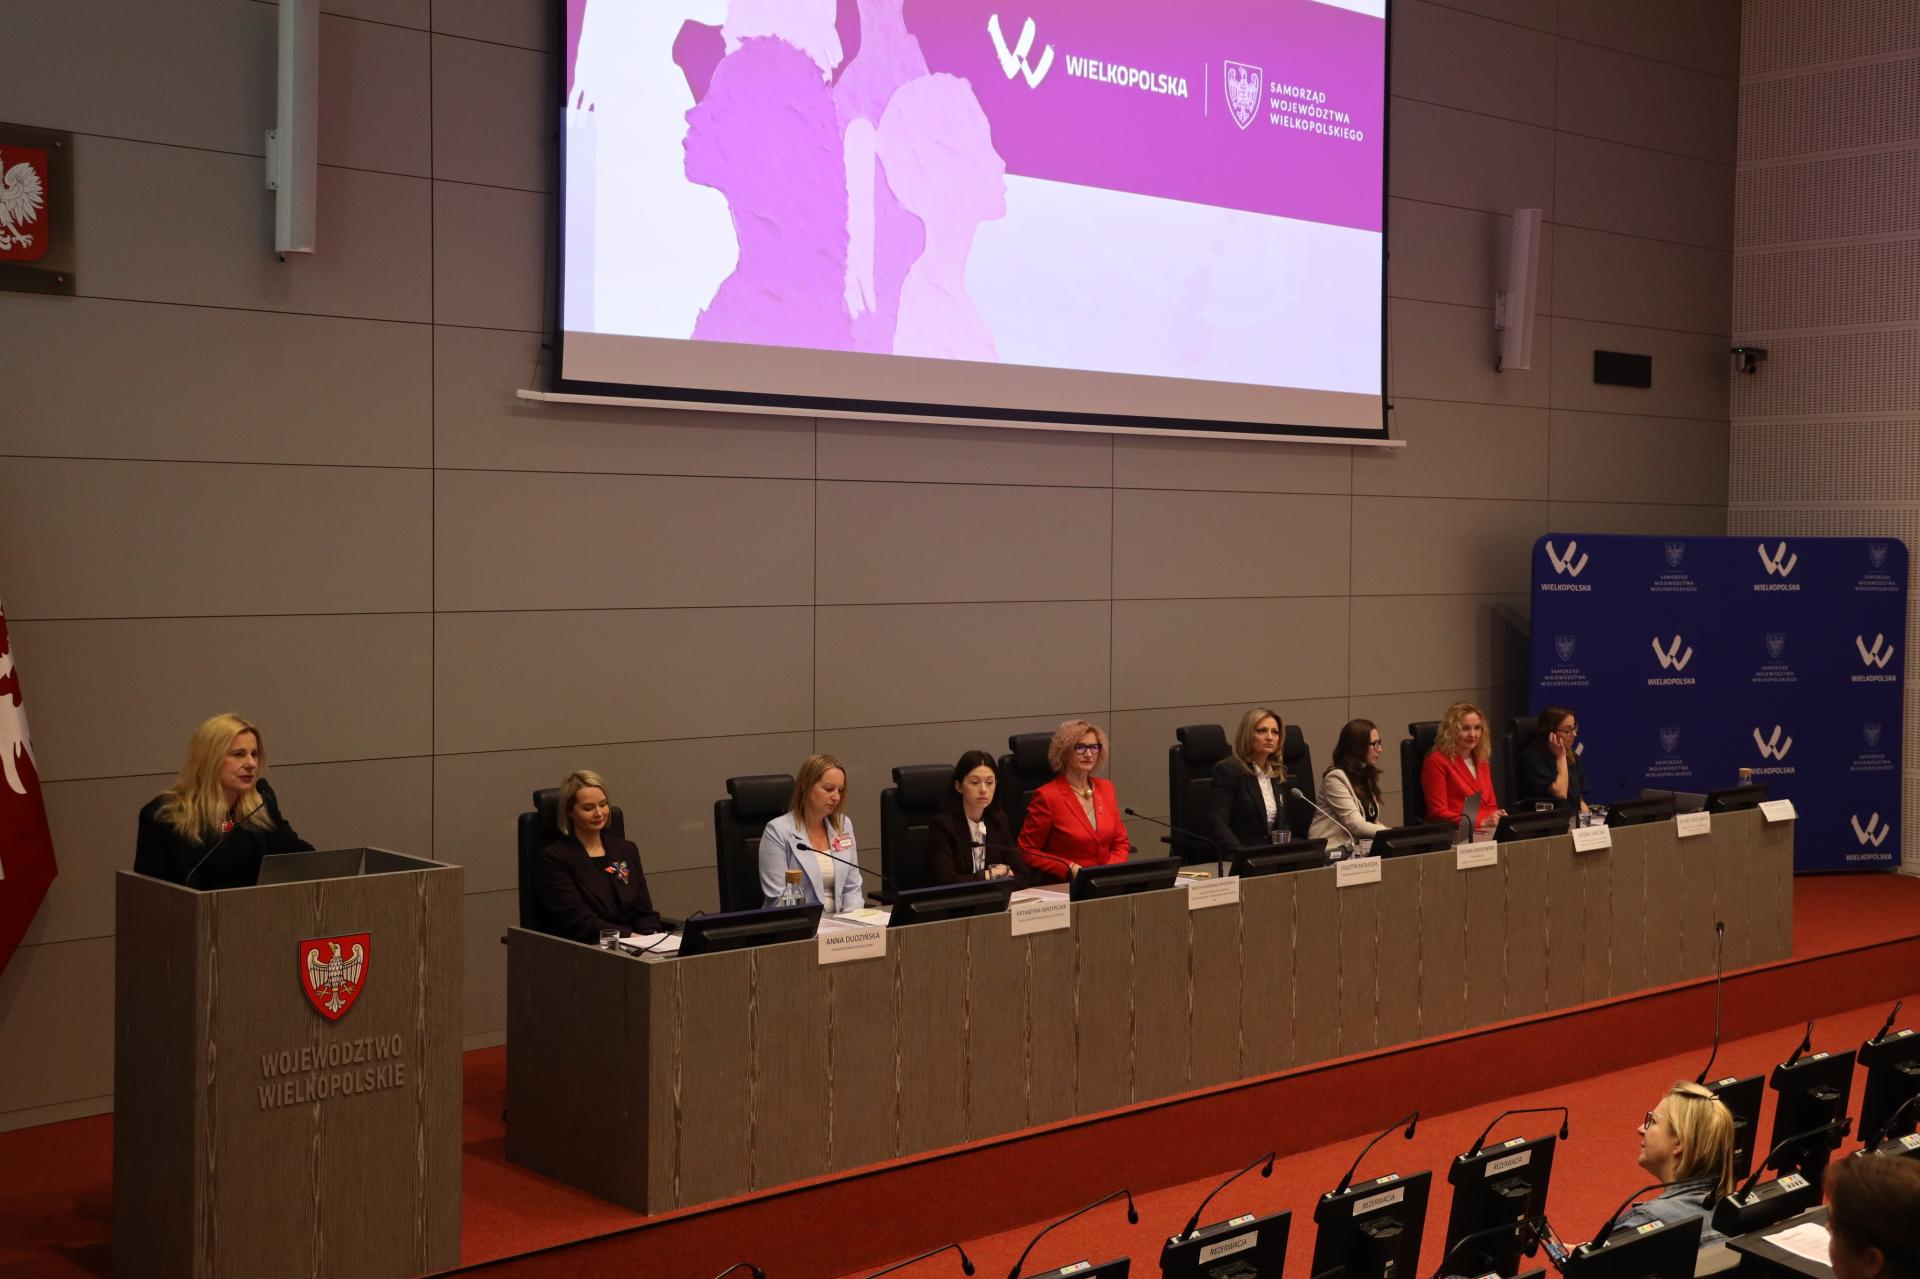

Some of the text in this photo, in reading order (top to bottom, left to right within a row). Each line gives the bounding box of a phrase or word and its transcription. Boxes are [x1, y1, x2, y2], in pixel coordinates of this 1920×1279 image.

[1065, 54, 1188, 98] WIELKOPOLSKA
[1270, 81, 1327, 104] SAMORZĄD
[1270, 96, 1350, 124] WOJEWÓDZTWA
[1270, 112, 1363, 142] WIELKOPOLSKIEGO
[1541, 583, 1592, 592] WIELKOPOLSKA
[1753, 583, 1800, 592] WIELKOPOLSKA
[1647, 677, 1696, 686] WIELKOPOLSKA
[1851, 674, 1896, 682] WIELKOPOLSKA
[1845, 853, 1892, 861] WIELKOPOLSKA
[825, 932, 880, 946] ANNA DUDZIŃSKA
[261, 1033, 403, 1078] WOJEWÓDZTWO
[258, 1063, 406, 1111] WIELKOPOLSKIE
[1493, 1156, 1522, 1170] REZERWACJA
[1362, 1193, 1395, 1209] REZERWACJA
[1209, 1238, 1248, 1256] REZERWACJA
